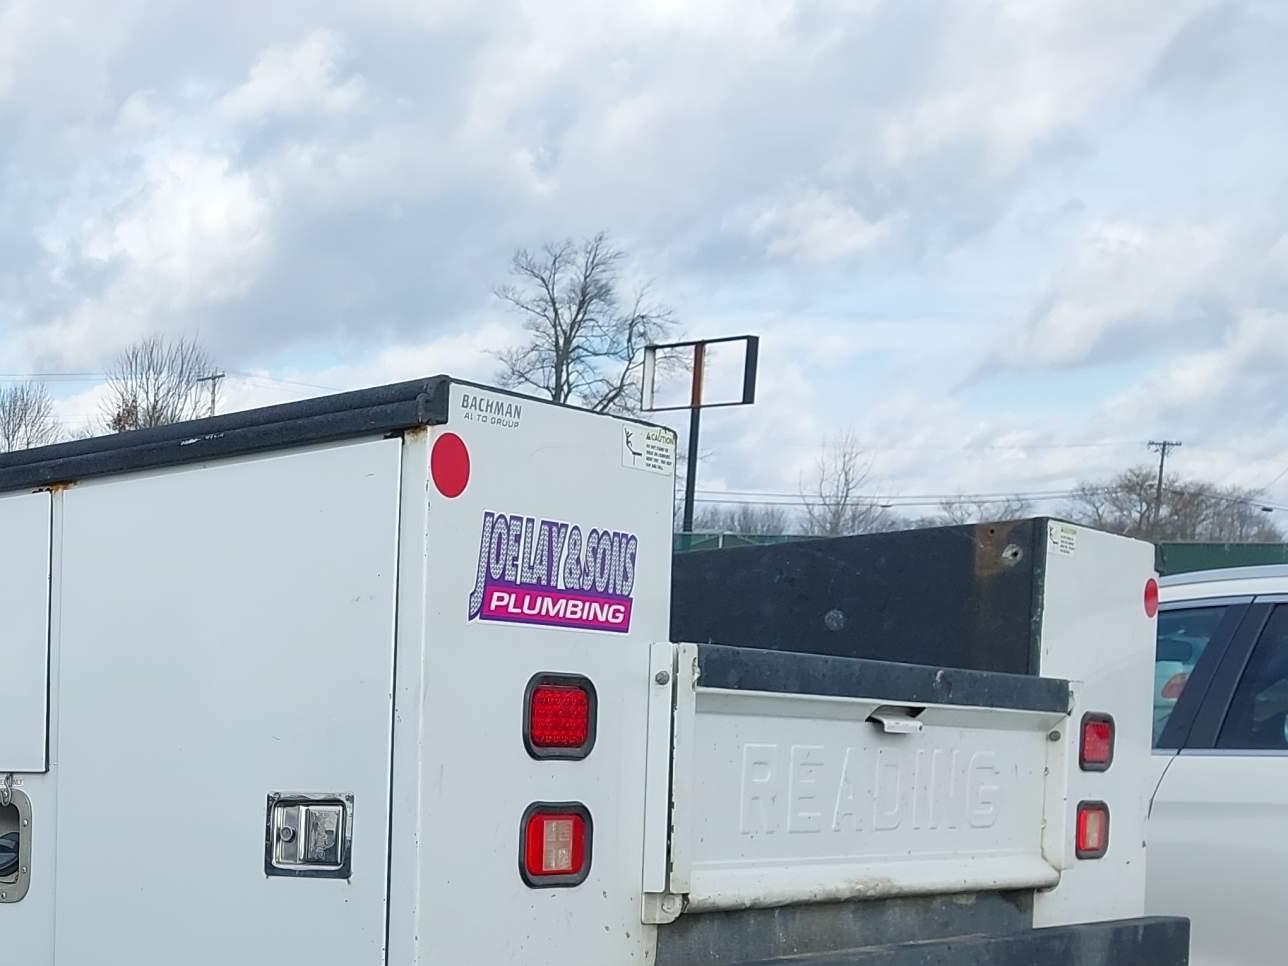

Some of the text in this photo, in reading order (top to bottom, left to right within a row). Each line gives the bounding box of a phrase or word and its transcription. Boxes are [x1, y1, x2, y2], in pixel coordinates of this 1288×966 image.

[462, 394, 522, 419] BACHMAN
[469, 512, 638, 620] JOE LAY & SONS
[490, 592, 625, 623] PLUMBING
[739, 743, 1000, 836] READING
